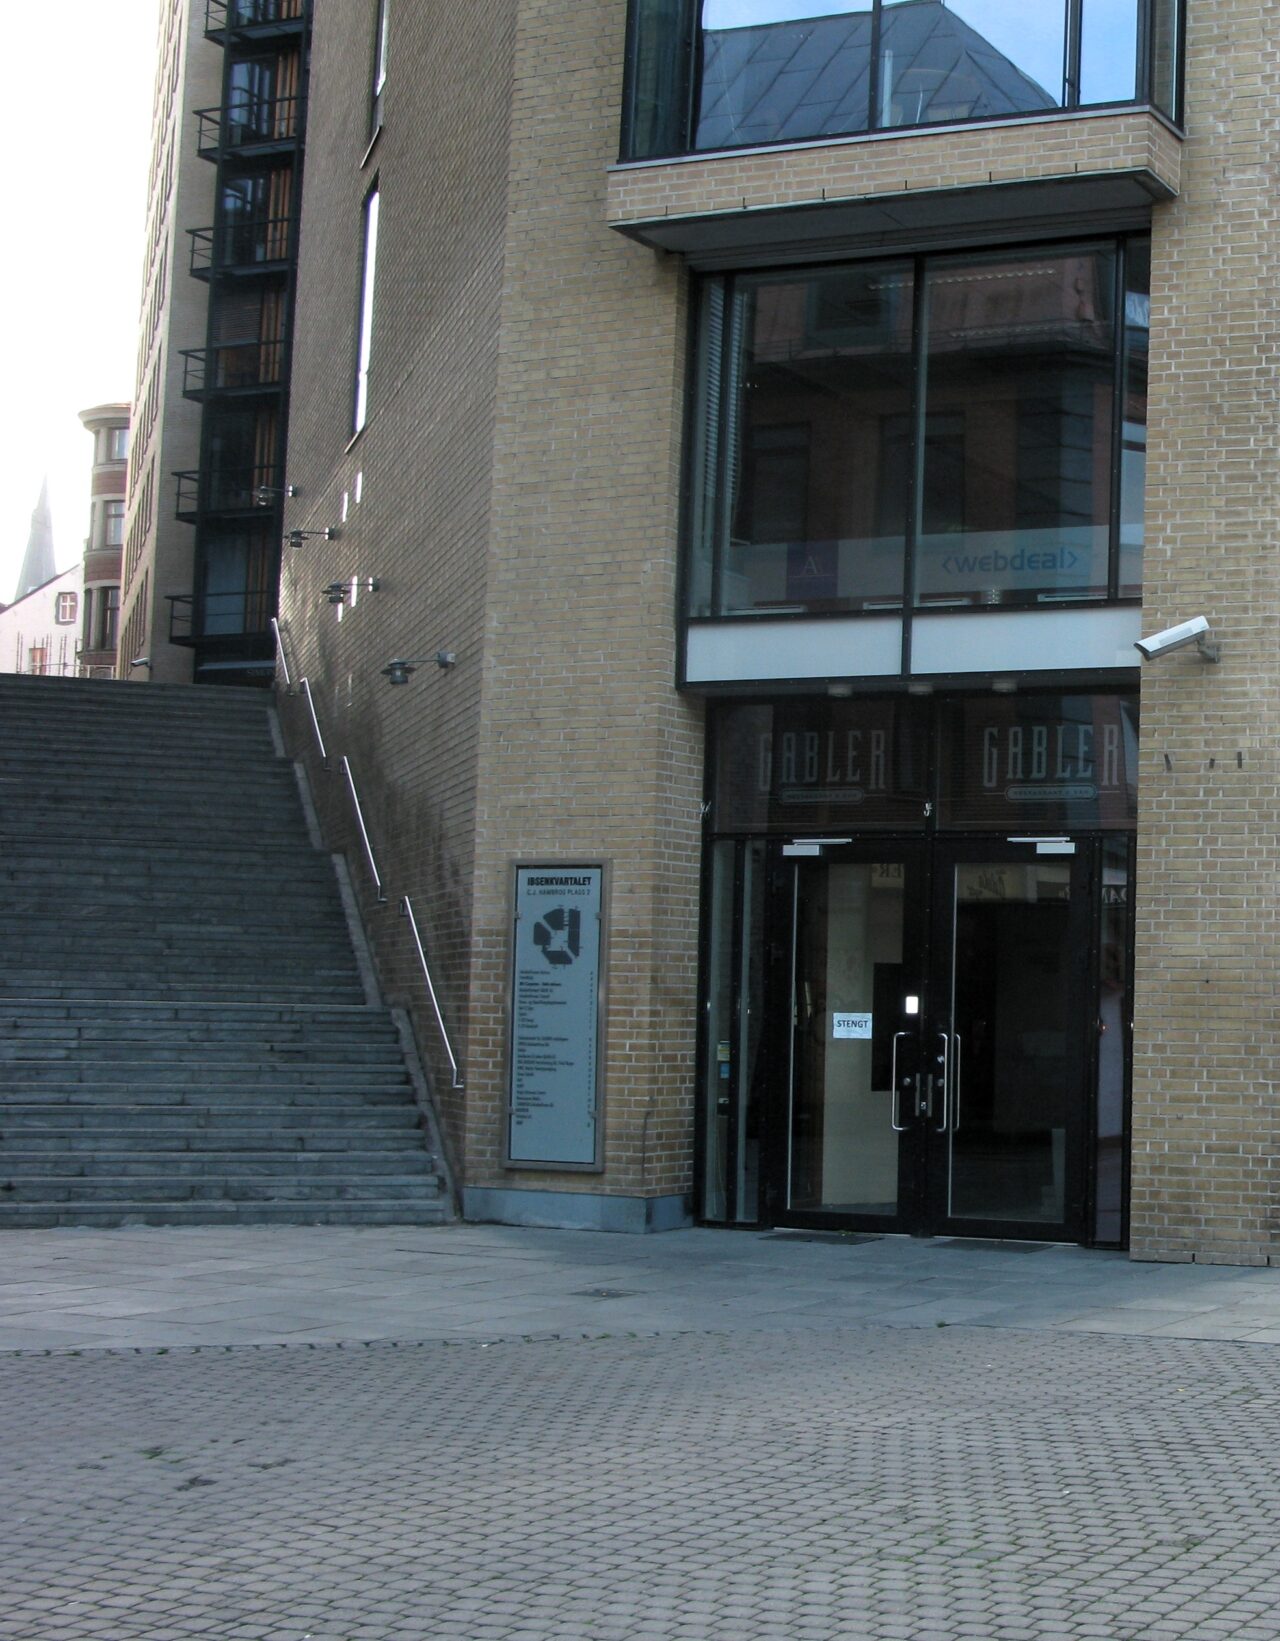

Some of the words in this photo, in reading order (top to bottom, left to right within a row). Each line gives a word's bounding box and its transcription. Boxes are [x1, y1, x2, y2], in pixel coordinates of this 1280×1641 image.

[758, 728, 886, 792] GABLER
[982, 723, 1120, 788] GABLER
[527, 876, 592, 886] IBSENKVARTALET
[836, 1019, 869, 1028] STENGT
